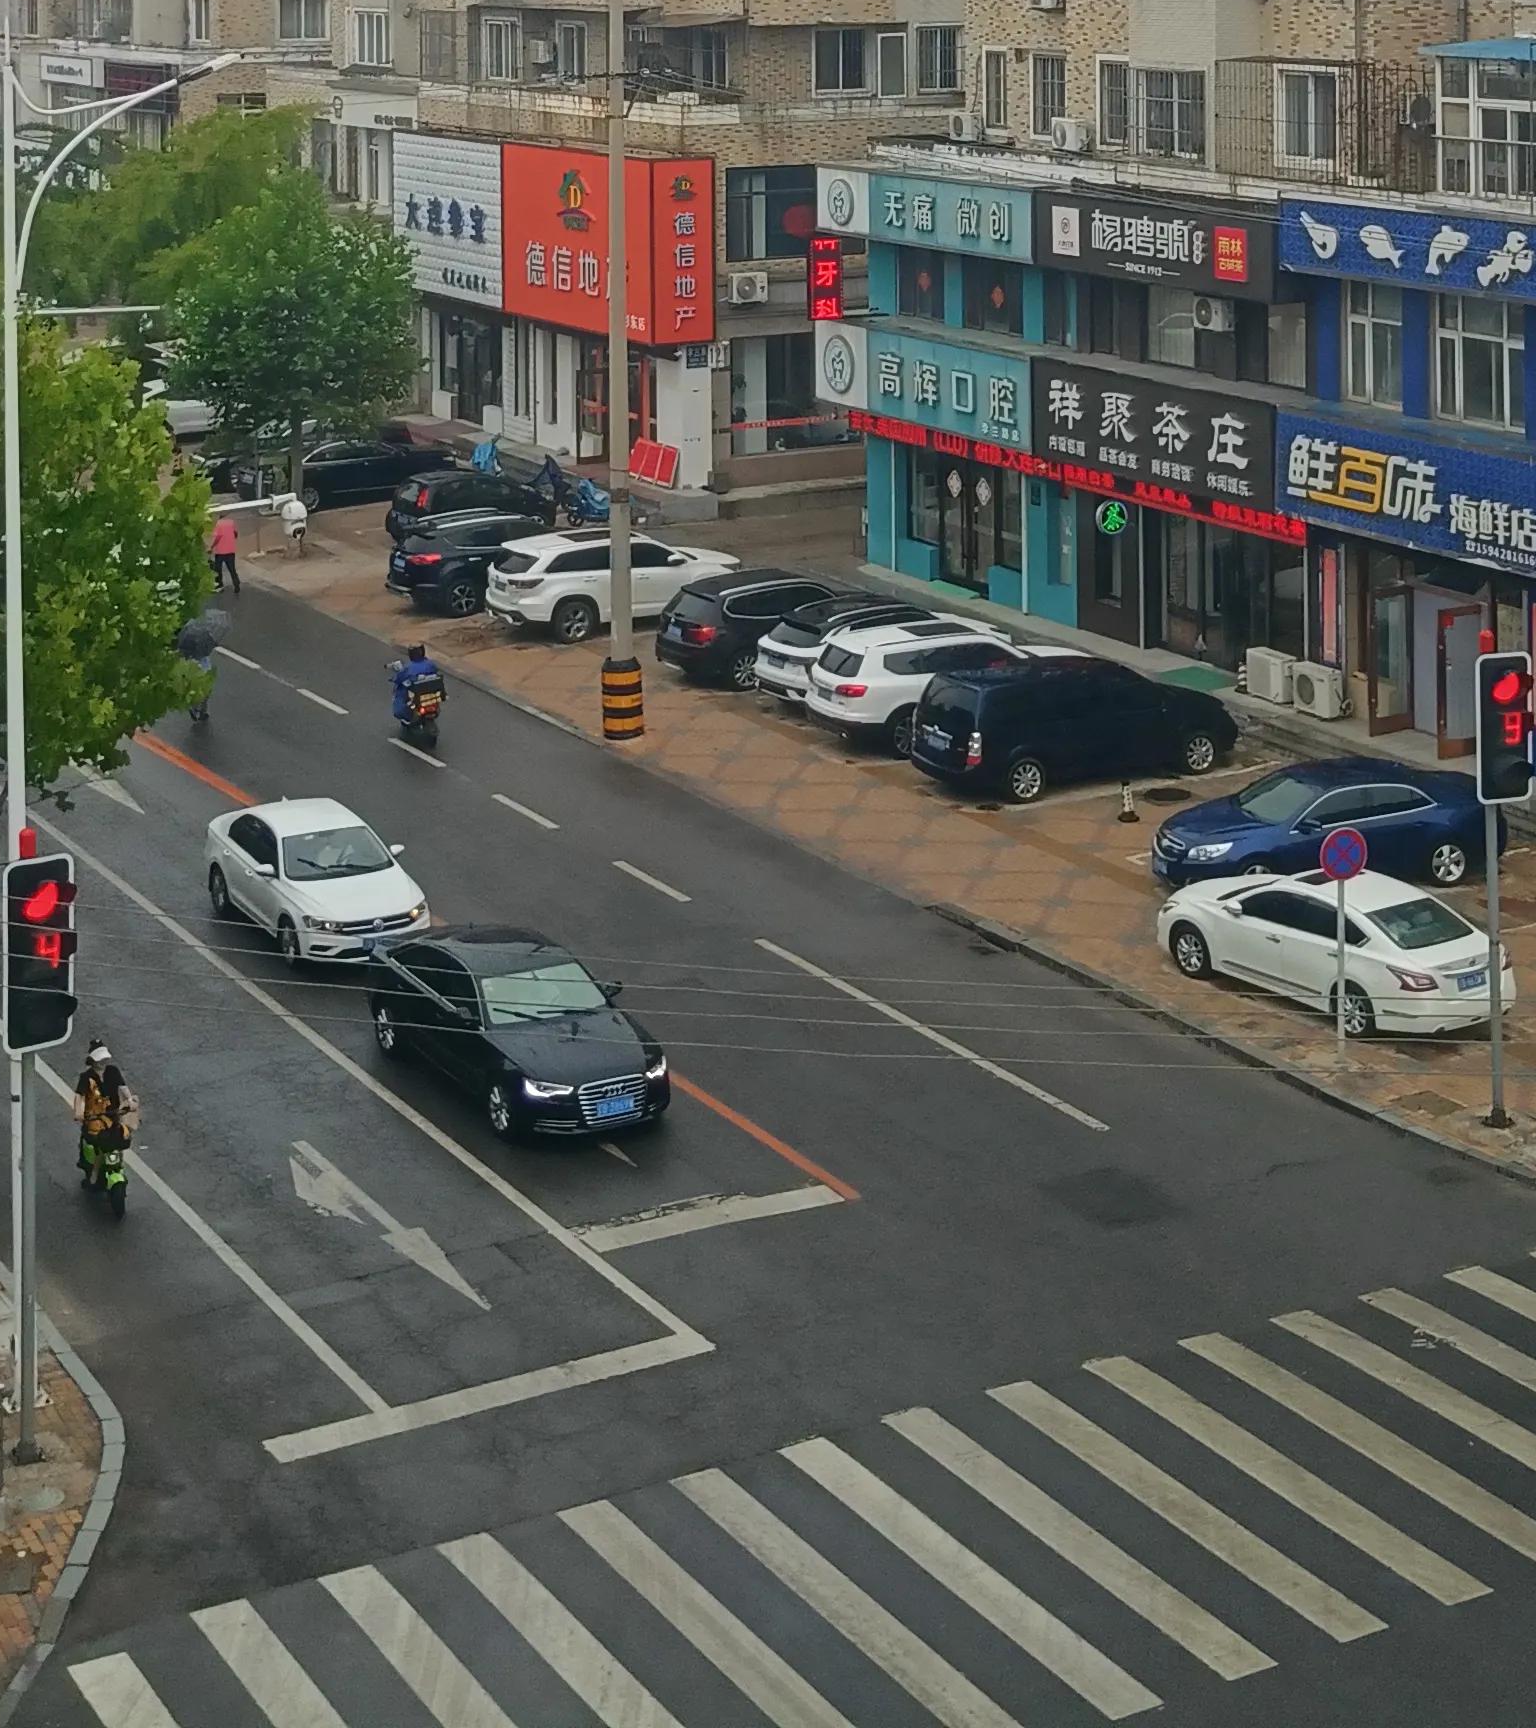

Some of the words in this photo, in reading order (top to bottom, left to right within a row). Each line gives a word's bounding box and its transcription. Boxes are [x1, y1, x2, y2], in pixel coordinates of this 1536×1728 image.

[883, 190, 935, 232] 无痛
[957, 198, 1010, 242] 微创
[525, 239, 610, 300] 德信地
[672, 211, 697, 332] 德信地产
[1218, 236, 1243, 257] 雨林
[877, 353, 1016, 425] 高辉口腔
[1048, 378, 1250, 470] 祥聚茶庄
[1206, 472, 1255, 498] 休闲娱乐
[1287, 433, 1446, 523] 鲜百味
[1104, 503, 1126, 531] 茶
[1504, 712, 1522, 745] 9
[37, 931, 62, 969] 4
